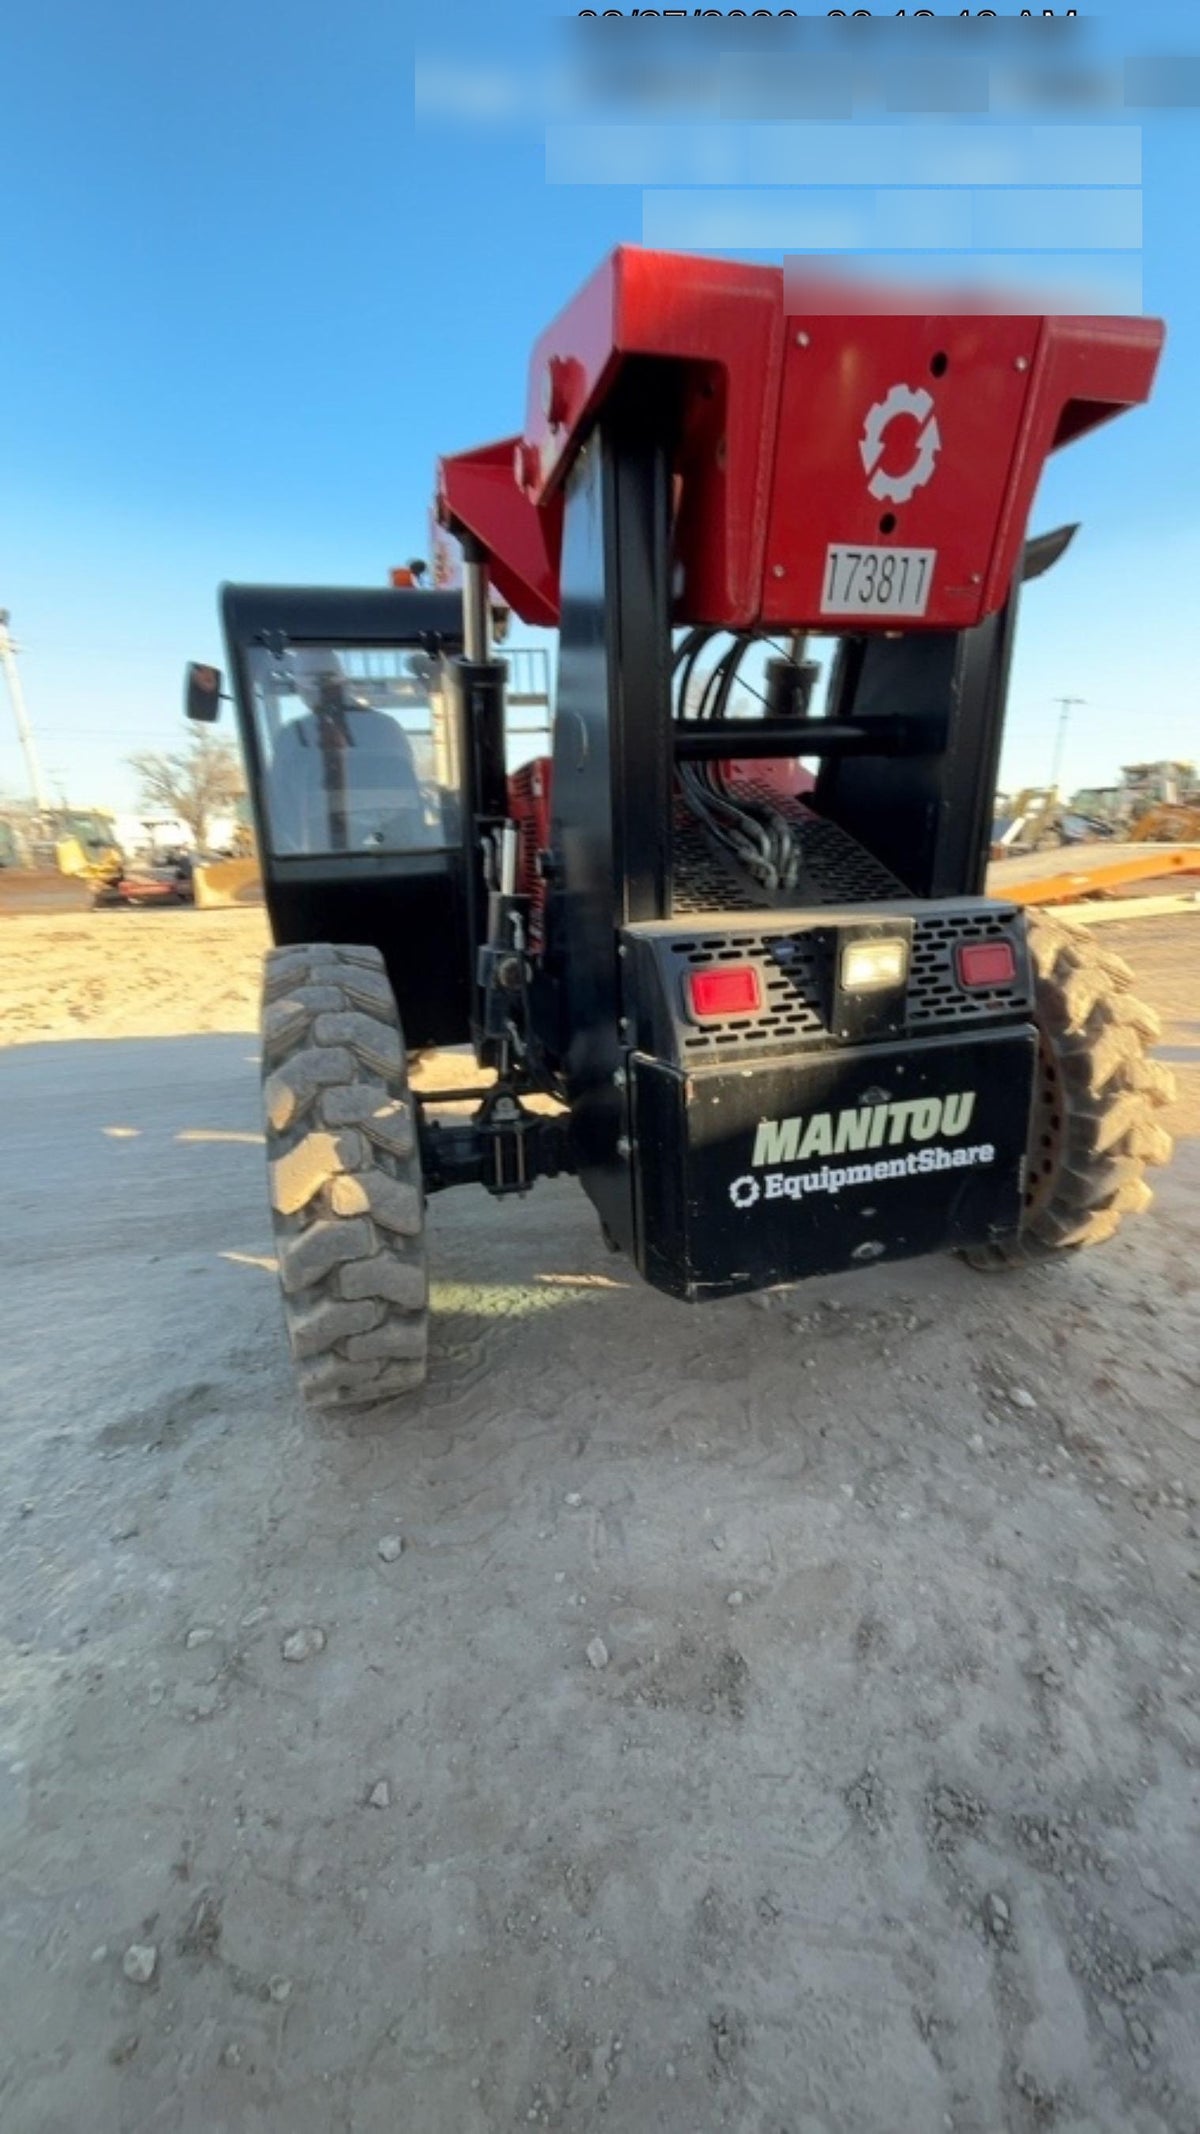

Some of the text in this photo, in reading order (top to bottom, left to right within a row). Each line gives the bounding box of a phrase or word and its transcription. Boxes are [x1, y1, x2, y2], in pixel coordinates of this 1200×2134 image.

[828, 553, 927, 604] 173811
[751, 1091, 976, 1167] MANITOU
[764, 1143, 995, 1199] EquipmentShare
